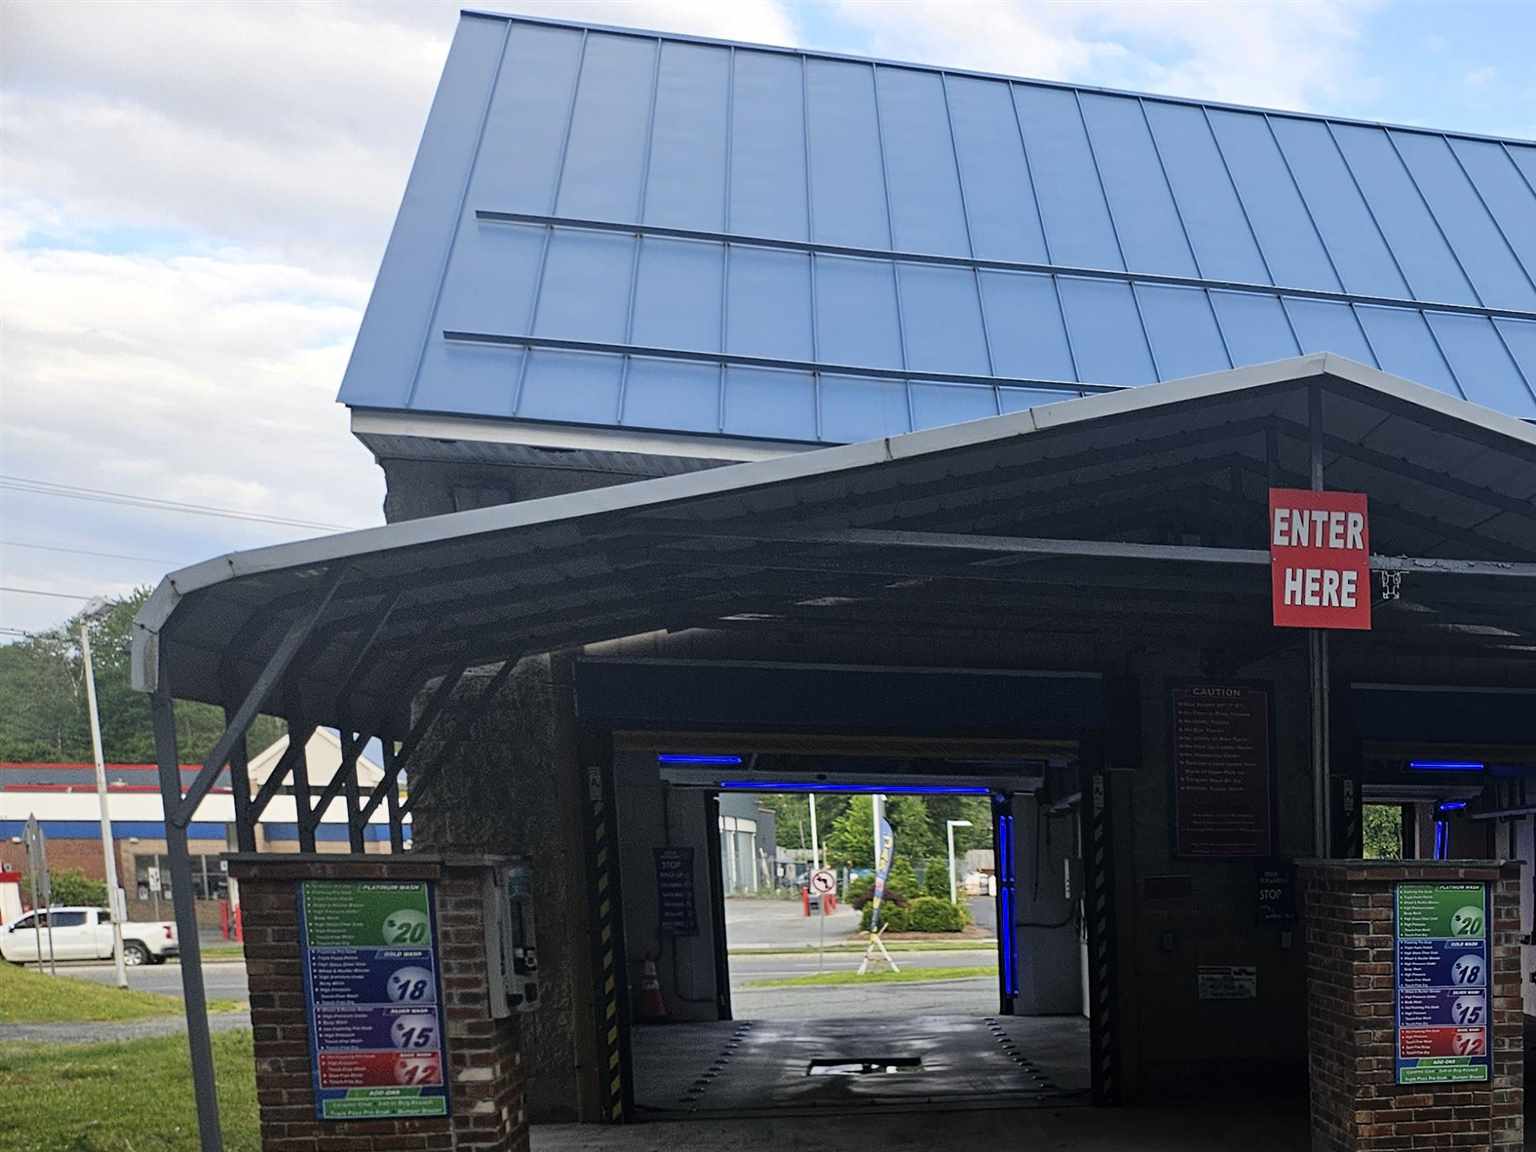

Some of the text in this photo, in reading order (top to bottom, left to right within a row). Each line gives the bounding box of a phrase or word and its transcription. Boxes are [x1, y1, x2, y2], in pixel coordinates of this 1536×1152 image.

[1273, 508, 1364, 550] ENTER
[1284, 568, 1358, 608] HERE
[1192, 687, 1241, 697] CAUTION
